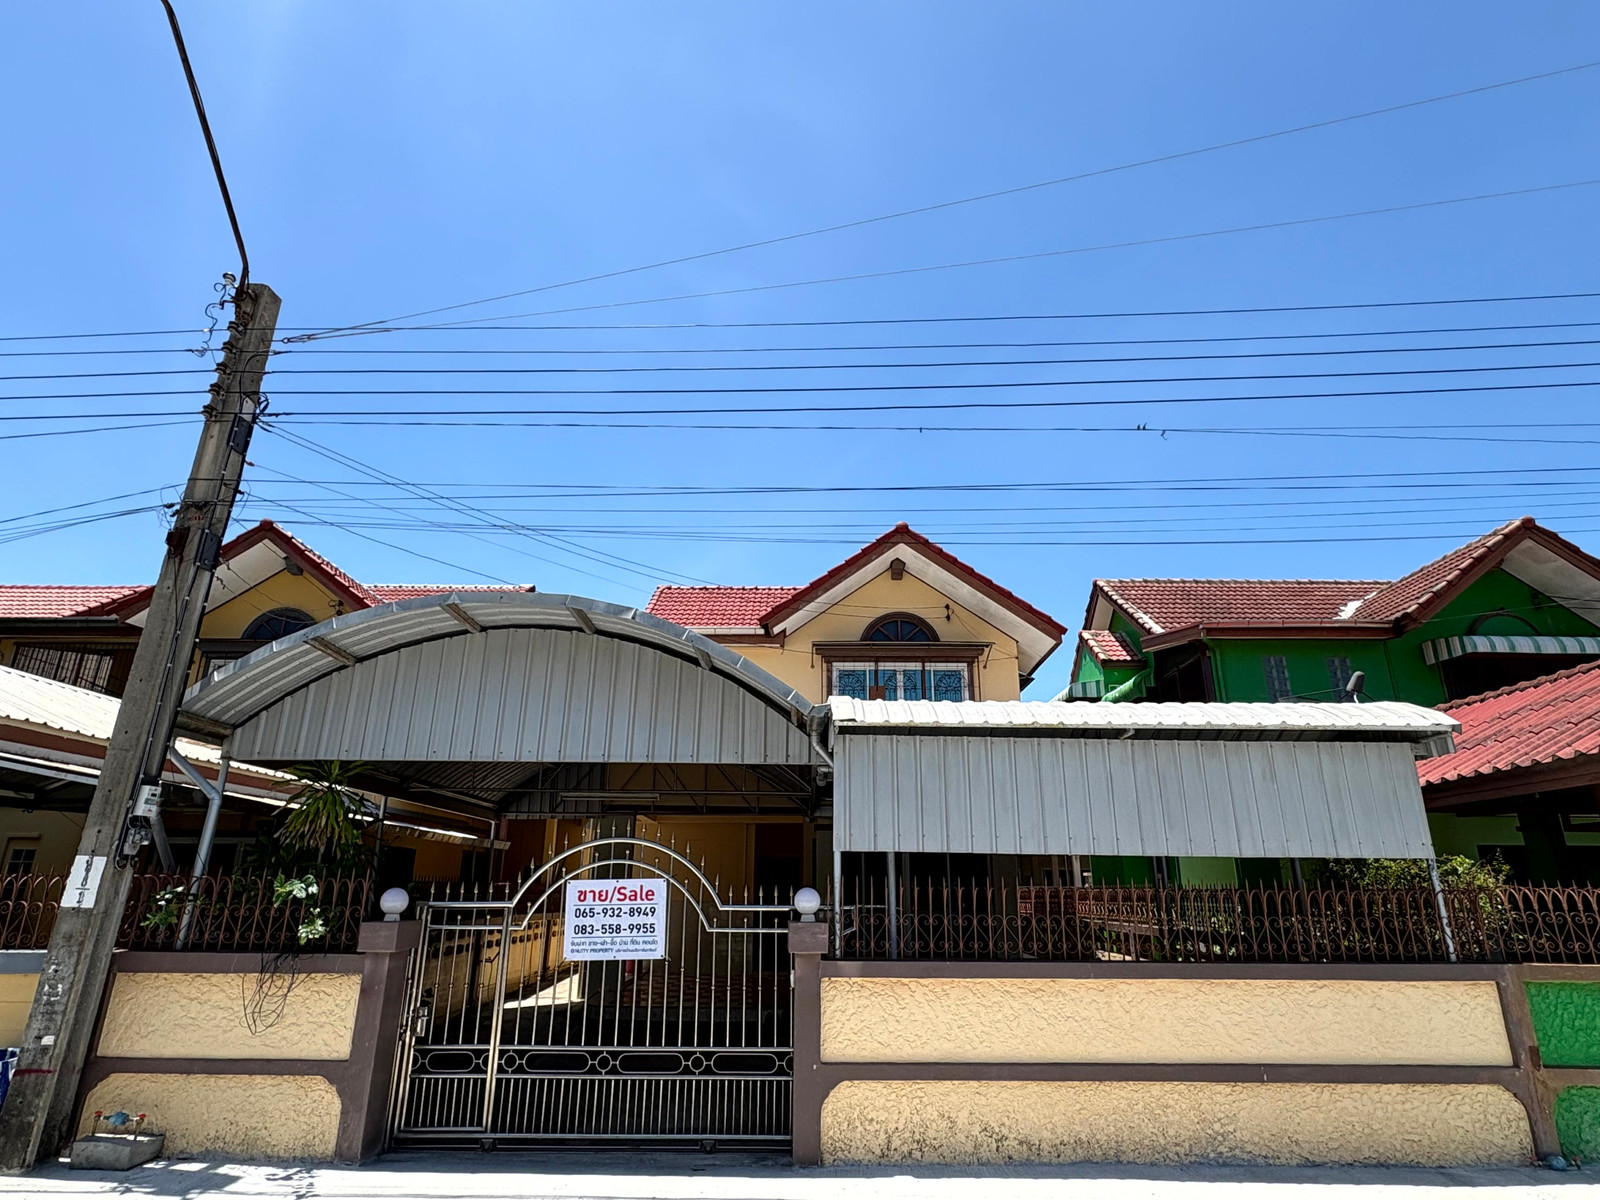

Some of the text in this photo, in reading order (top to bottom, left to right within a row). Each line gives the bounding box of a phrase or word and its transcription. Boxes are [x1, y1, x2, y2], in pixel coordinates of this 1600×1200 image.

[577, 884, 655, 903] ขาย/Sale
[574, 906, 656, 918] 065-932-8949
[573, 923, 656, 935] 083-558-9955
